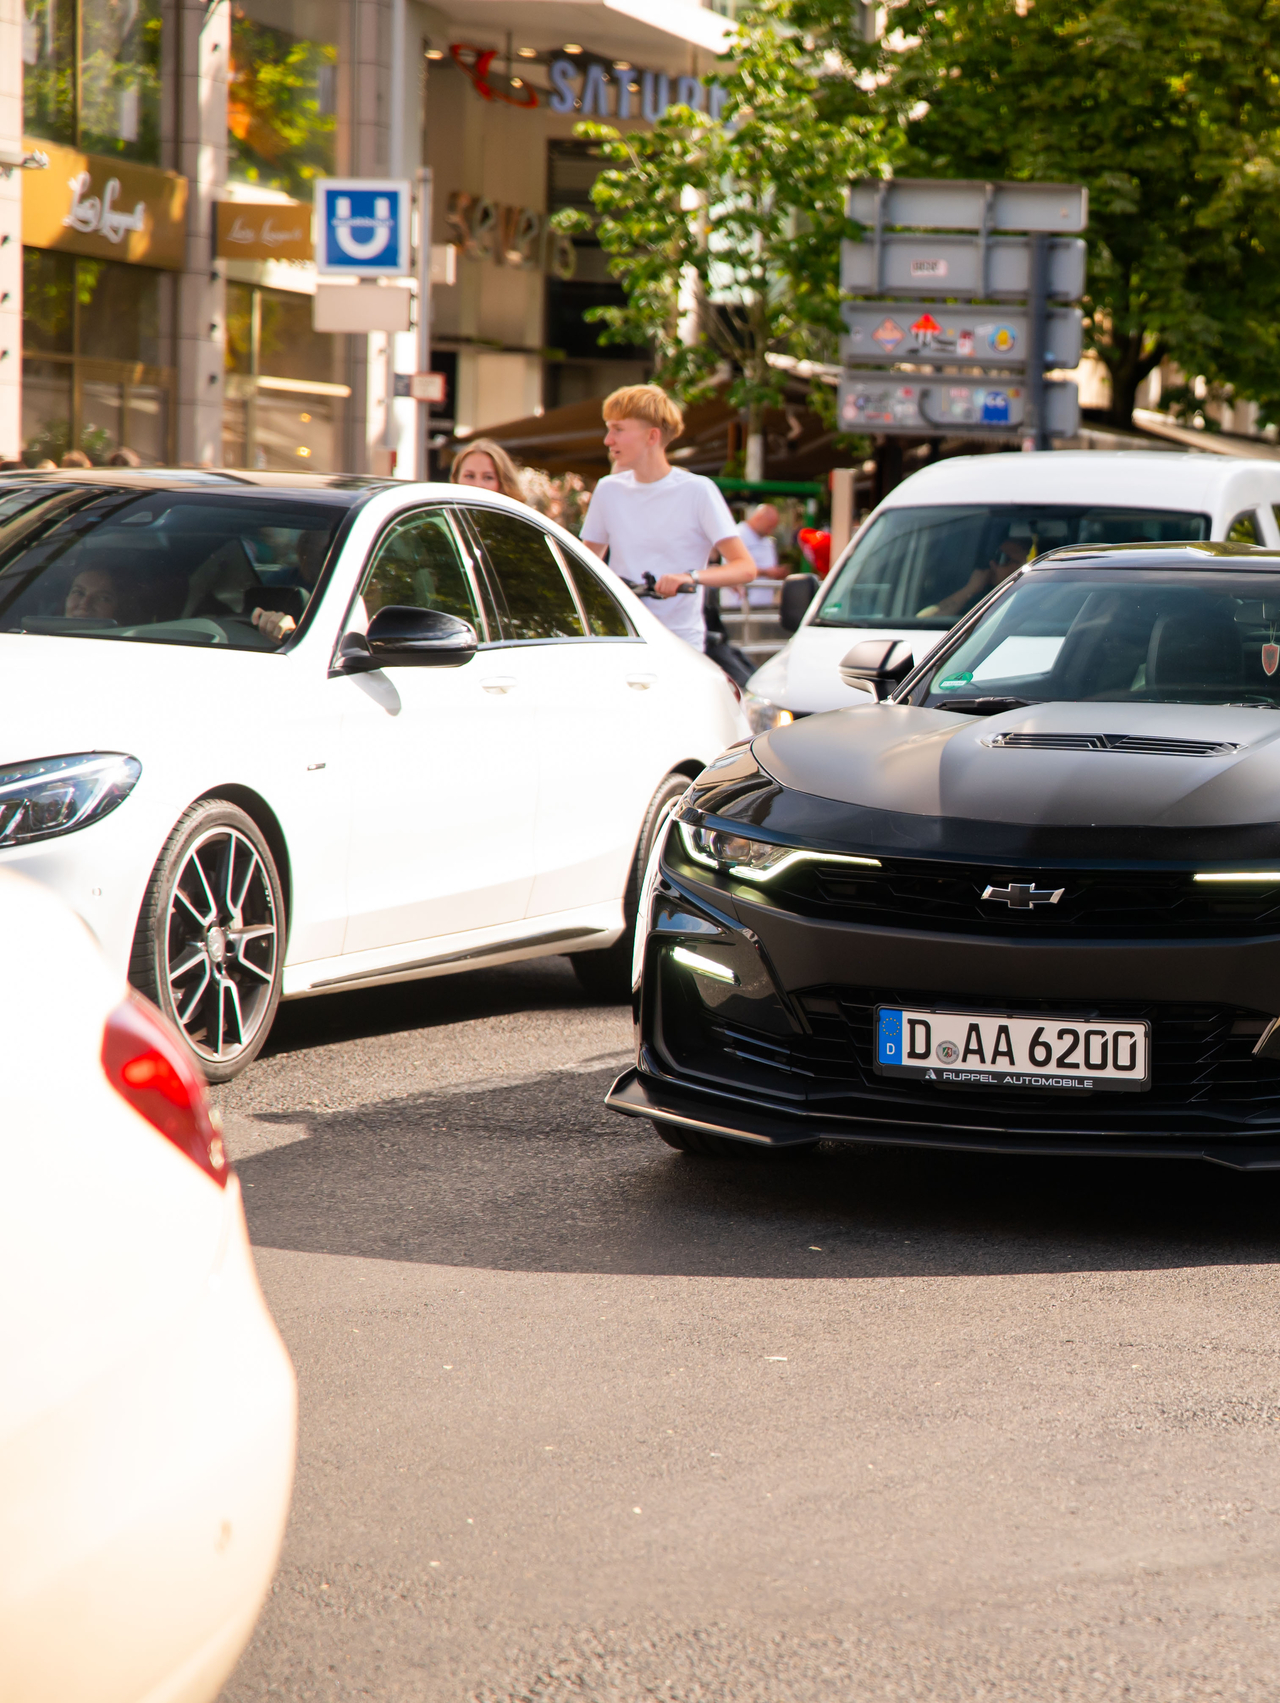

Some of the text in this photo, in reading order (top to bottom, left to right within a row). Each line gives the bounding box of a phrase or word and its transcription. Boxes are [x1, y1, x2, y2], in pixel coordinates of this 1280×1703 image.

[335, 196, 390, 260] U
[886, 1043, 895, 1055] D
[907, 1018, 931, 1060] D
[961, 1022, 1016, 1066] AA
[1028, 1026, 1137, 1071] 6200
[943, 1072, 1094, 1088] RUPPEL AUTOMOBILE
